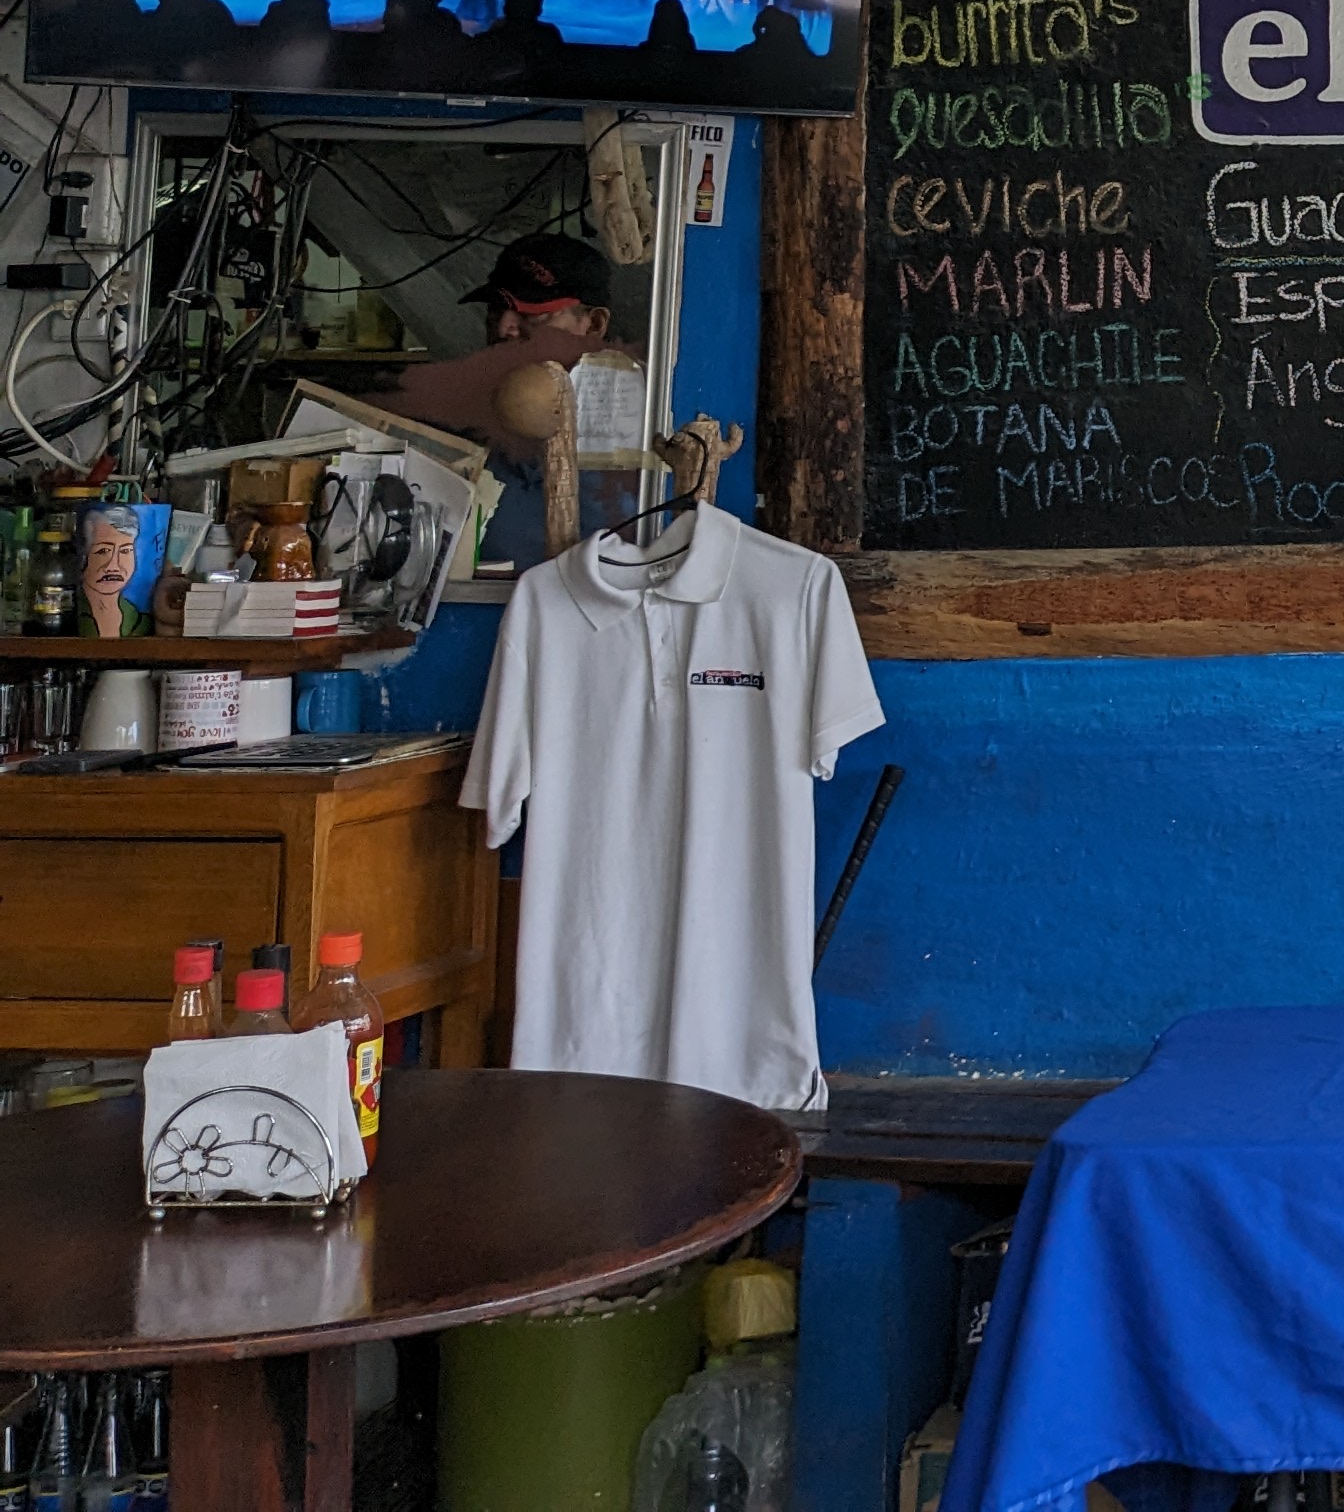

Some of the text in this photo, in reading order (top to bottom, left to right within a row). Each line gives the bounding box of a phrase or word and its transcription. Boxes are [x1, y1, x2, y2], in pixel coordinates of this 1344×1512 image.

[897, 247, 1151, 317] MARLIN
[893, 322, 1186, 399] AGUACHILE
[891, 401, 1122, 463] BOTANA
[899, 465, 966, 522] DE
[706, 673, 760, 686] anuelo
